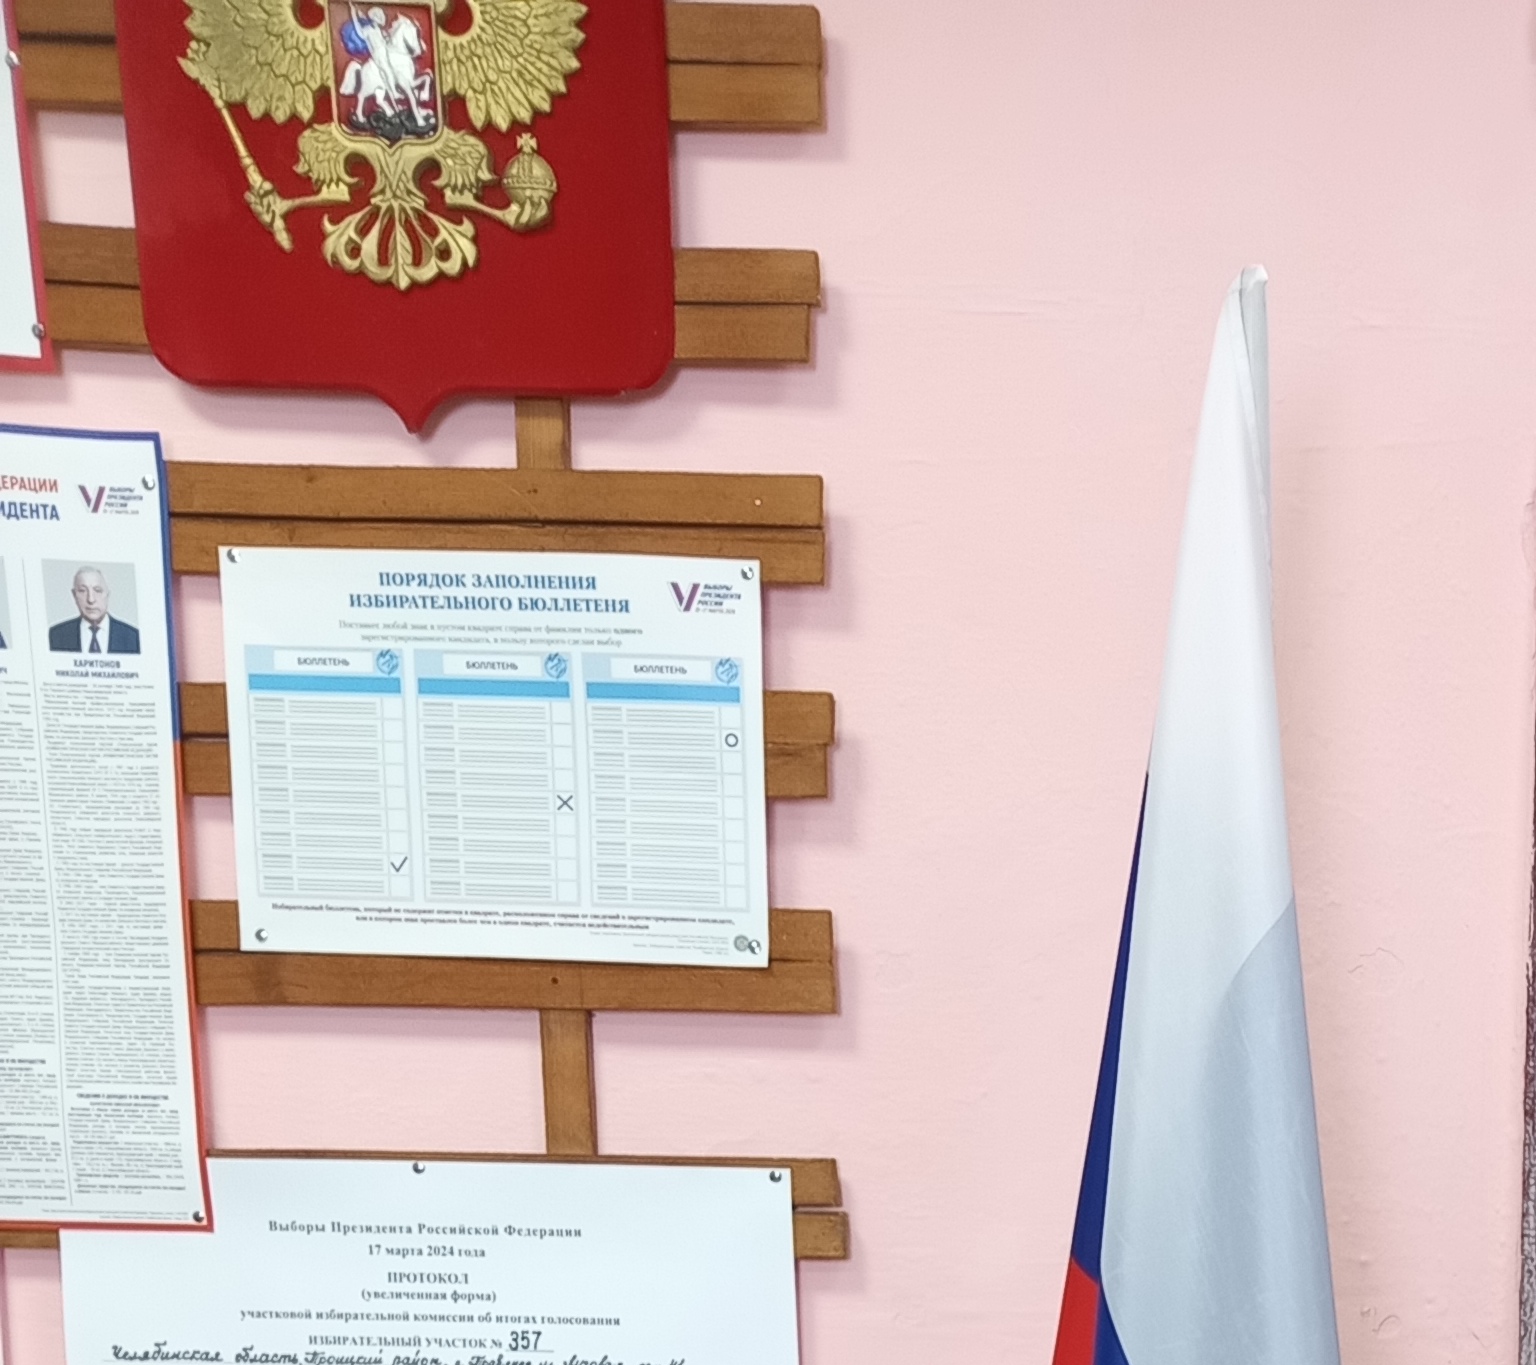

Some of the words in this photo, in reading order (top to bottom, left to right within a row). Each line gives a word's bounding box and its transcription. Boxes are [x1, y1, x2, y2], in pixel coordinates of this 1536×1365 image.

[0, 474, 58, 494] ЕРАЦИИ
[378, 571, 466, 589] ПОРЯДОК
[471, 573, 597, 590] ЗАПОЛНЕНИЯ
[349, 593, 513, 611] ИЗБИРАТЕЛЬНОГО
[517, 596, 630, 613] БЮЛЛЕТЕНЯ
[296, 656, 350, 666] БЮЛЛЕТЕНЬ
[465, 660, 518, 671] БЮЛЛЕТЕНЬ
[633, 664, 687, 675] БЮЛЛЕТЕНЬ
[268, 1220, 325, 1235] Выборы
[330, 1221, 412, 1236] Президента
[417, 1222, 499, 1235] Российской
[503, 1224, 582, 1240] Федерации
[368, 1244, 381, 1255] 17
[385, 1247, 423, 1259] марта
[426, 1244, 454, 1257] 2024
[457, 1248, 485, 1257] года
[387, 1271, 468, 1284] ПРОТОКОЛ
[361, 1288, 447, 1302] (увеличенная
[450, 1289, 496, 1304] форма)
[240, 1309, 312, 1321] участковой
[315, 1308, 409, 1323] избирательной
[413, 1313, 474, 1323] комиссии
[477, 1311, 492, 1323] об
[495, 1315, 537, 1324] итогах
[540, 1315, 620, 1326] голосования
[308, 1335, 422, 1350] ИЗБИРАТЕЛЬНЫЙ
[425, 1337, 487, 1349] УЧАСТОК
[489, 1338, 502, 1349] №
[508, 1330, 542, 1351] 357
